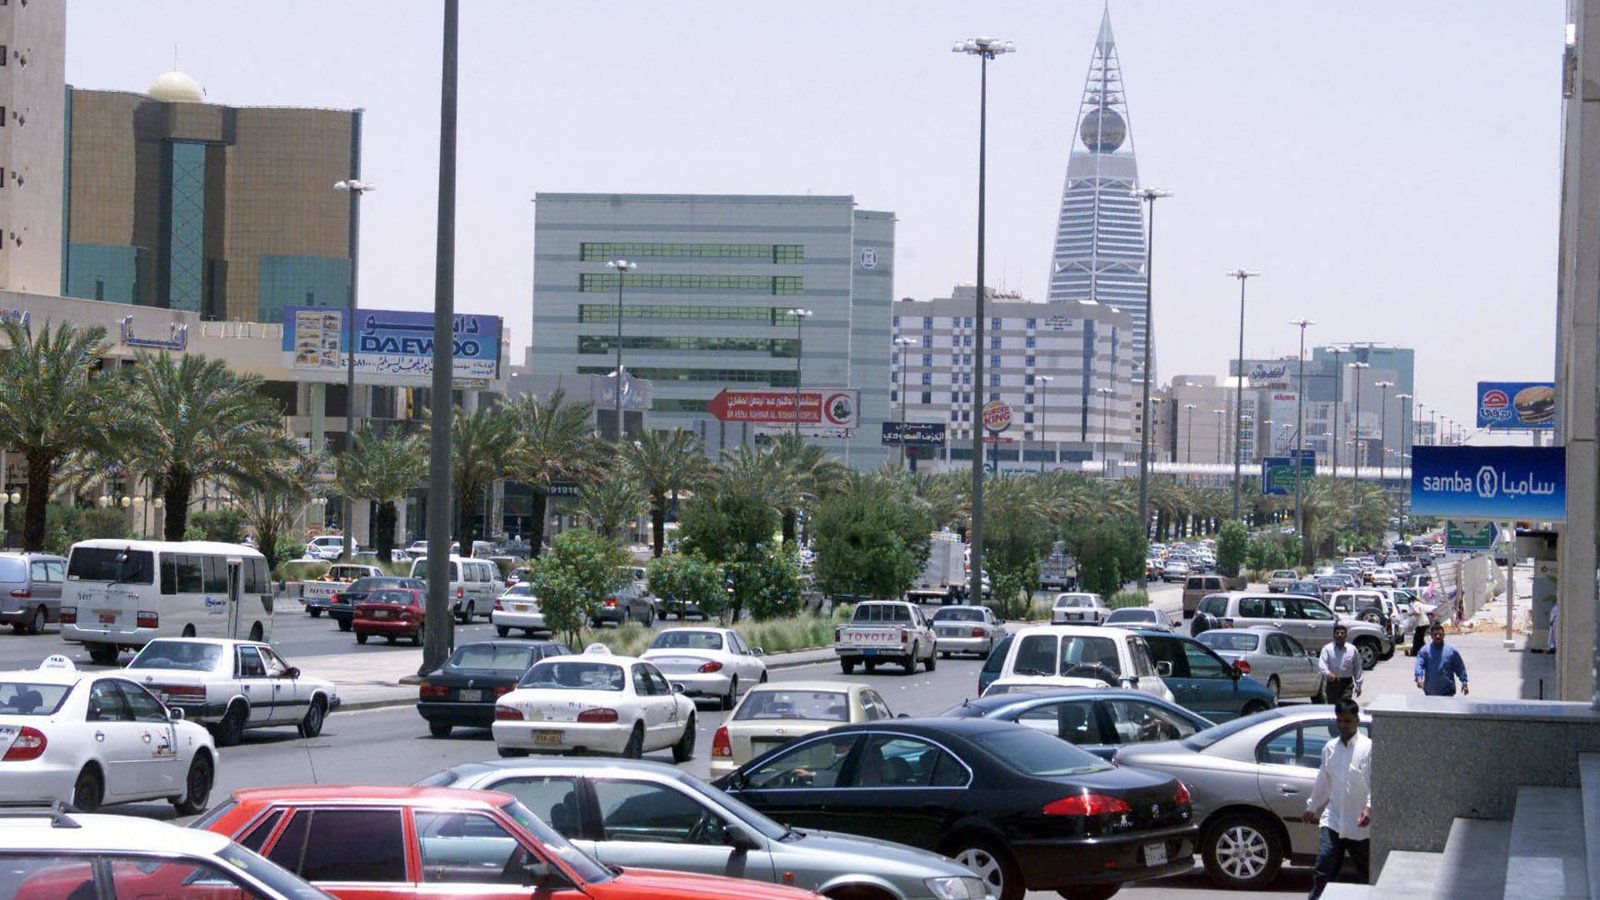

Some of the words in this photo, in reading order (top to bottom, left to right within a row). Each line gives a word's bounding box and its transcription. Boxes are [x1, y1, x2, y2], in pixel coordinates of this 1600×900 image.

[984, 411, 1010, 425] KING
[1423, 470, 1472, 492] samba
[1502, 471, 1555, 499] سامبا
[847, 632, 895, 641] TOYOTA
